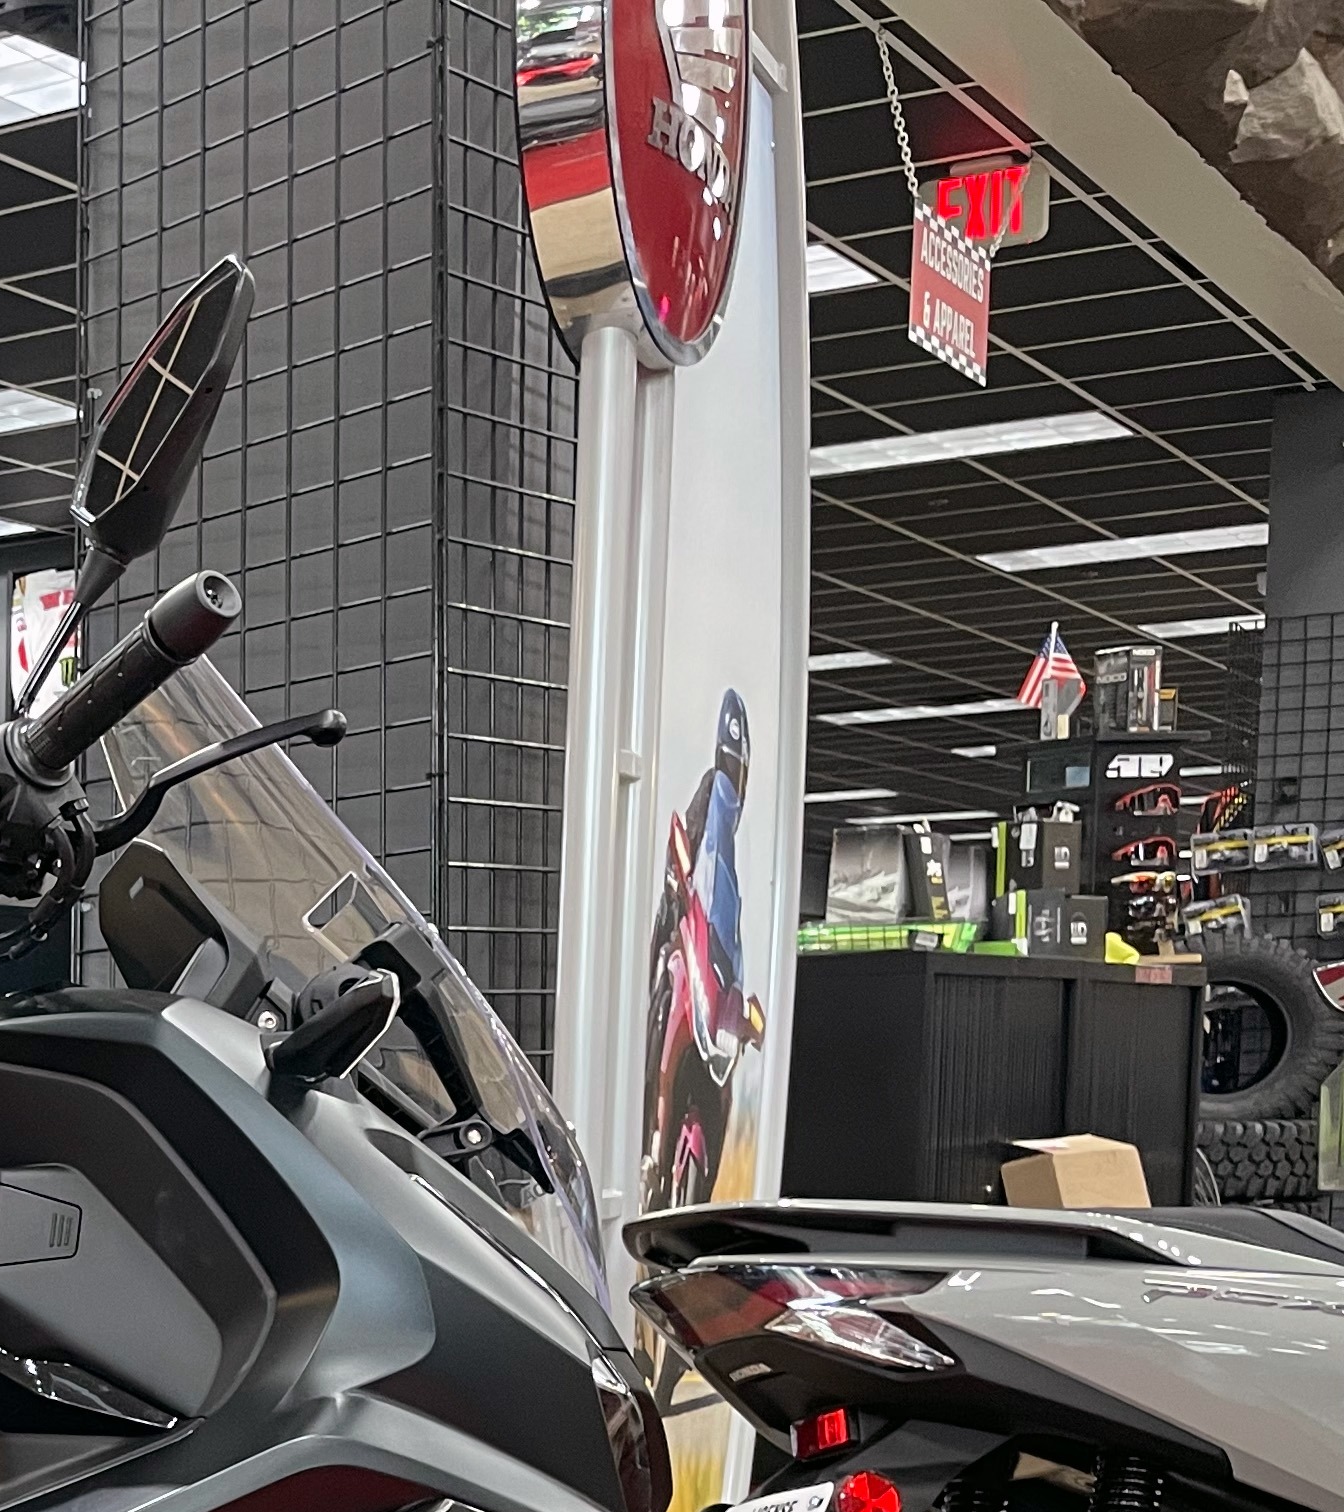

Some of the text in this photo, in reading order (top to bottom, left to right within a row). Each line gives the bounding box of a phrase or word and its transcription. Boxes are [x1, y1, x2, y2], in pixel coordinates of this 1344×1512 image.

[937, 165, 1027, 240] EXIT
[920, 227, 985, 304] ACCESSORIES
[923, 291, 976, 359] & APPAREL
